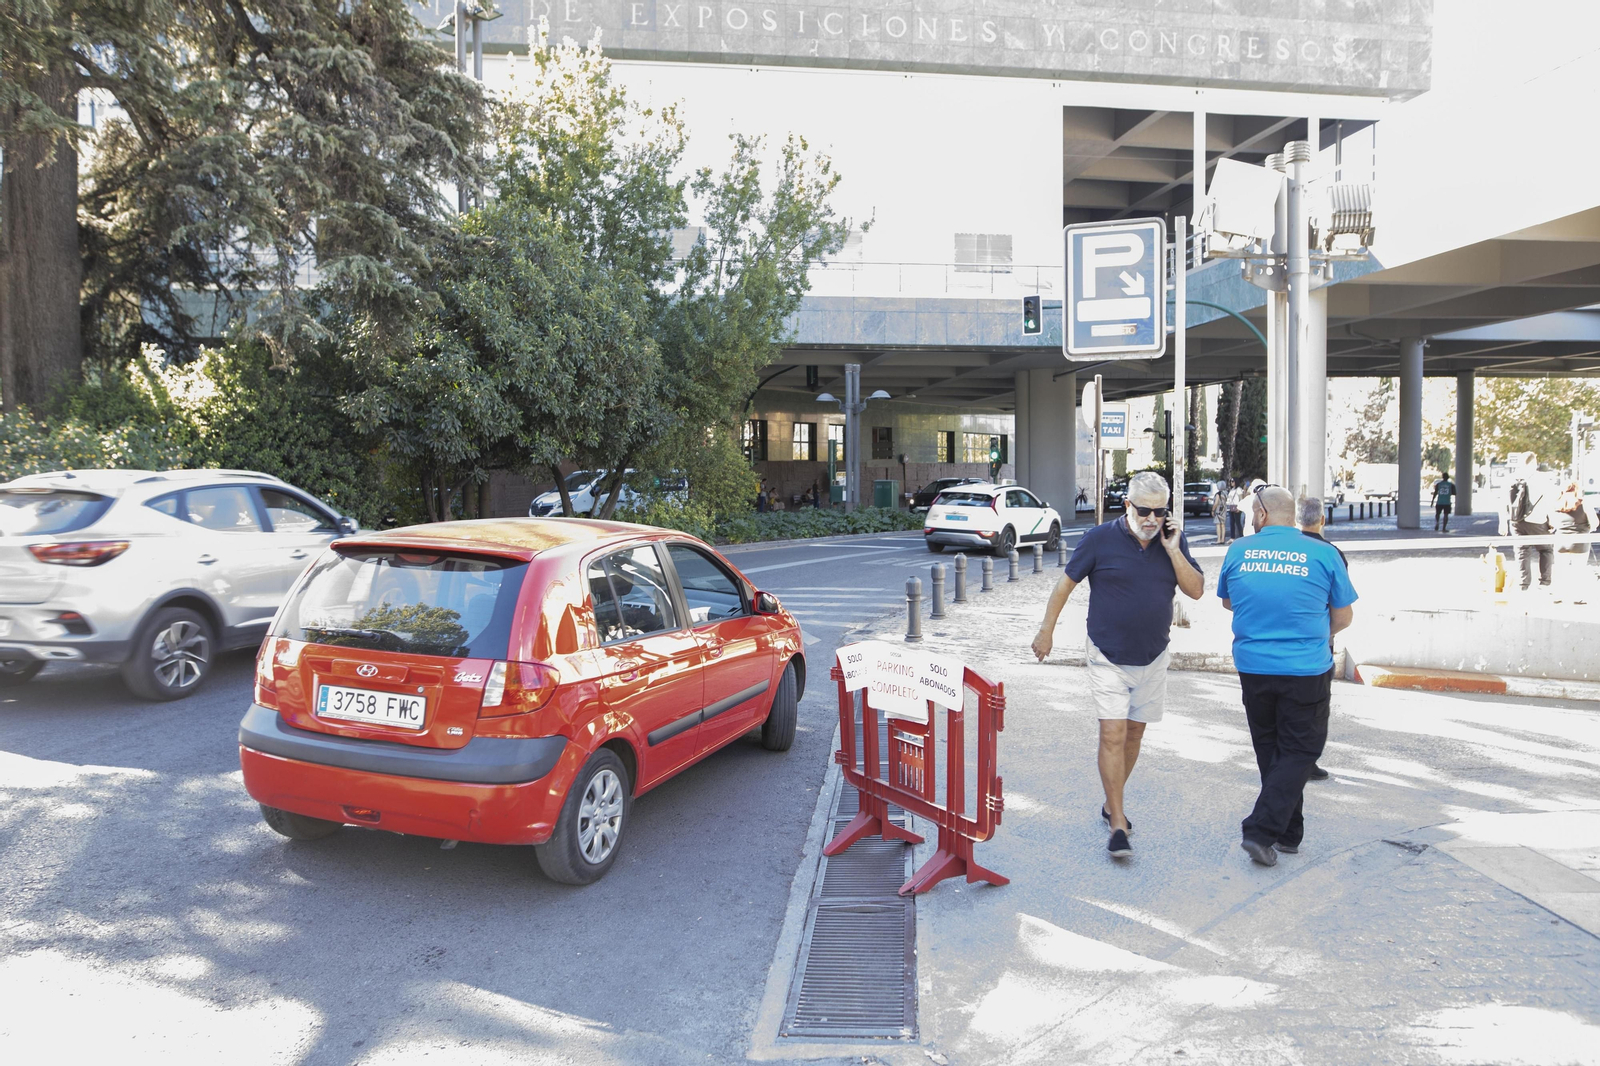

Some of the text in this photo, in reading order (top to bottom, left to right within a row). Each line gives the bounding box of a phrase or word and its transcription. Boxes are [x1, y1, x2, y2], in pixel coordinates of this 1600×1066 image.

[529, 0, 1347, 63] DE EXPOSICIONES Y CONGRESOS
[1082, 232, 1145, 299] P
[1102, 426, 1121, 434] TAXI
[1244, 549, 1307, 563] SERVICIOS
[1239, 562, 1309, 577] AUXILIARES
[847, 652, 863, 664] SOLO
[876, 660, 915, 678] PARKING
[929, 663, 948, 677] SOLO
[453, 671, 483, 683] Getz
[919, 676, 956, 698] ABONADOS
[333, 690, 420, 721] 3758 FWC
